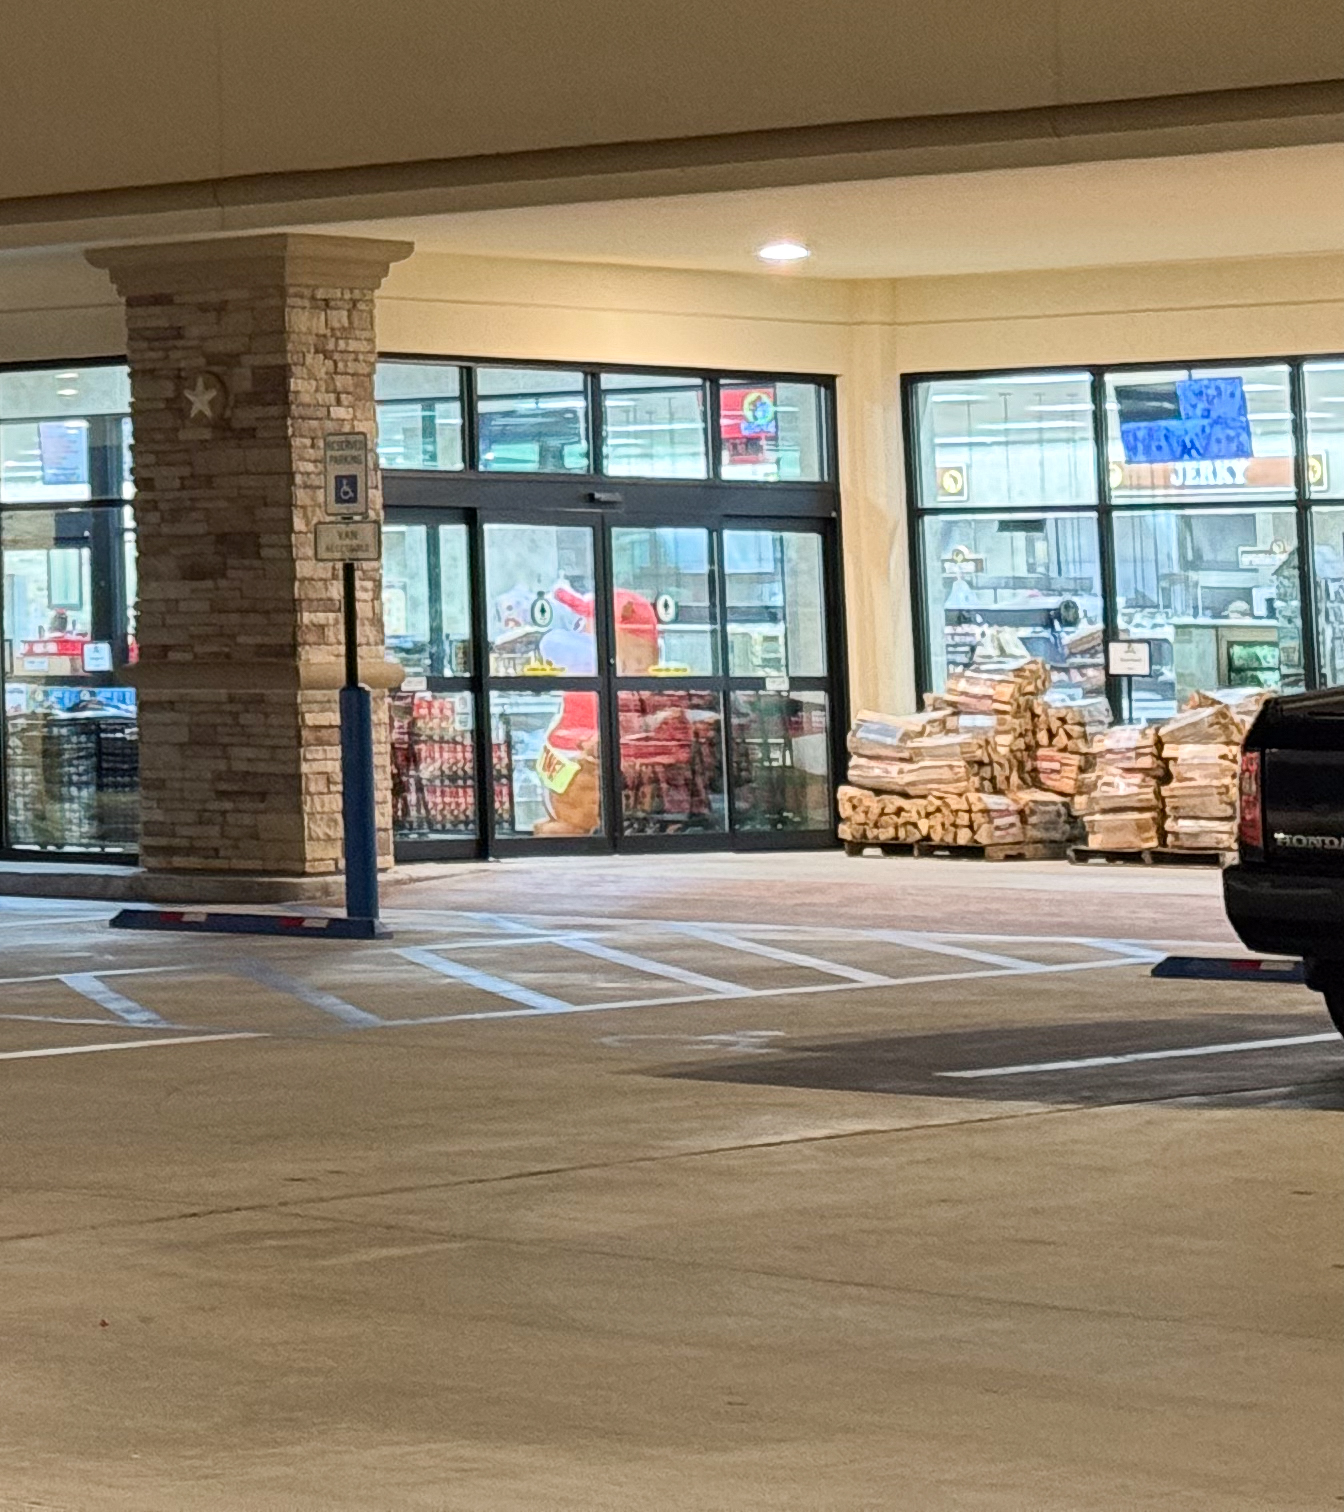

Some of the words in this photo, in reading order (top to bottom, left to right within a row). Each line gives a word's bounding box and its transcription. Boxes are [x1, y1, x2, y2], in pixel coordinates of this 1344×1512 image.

[328, 454, 364, 465] PARKING
[1171, 461, 1250, 485] JERKY
[336, 530, 358, 541] VAN
[1274, 833, 1344, 849] HOND
